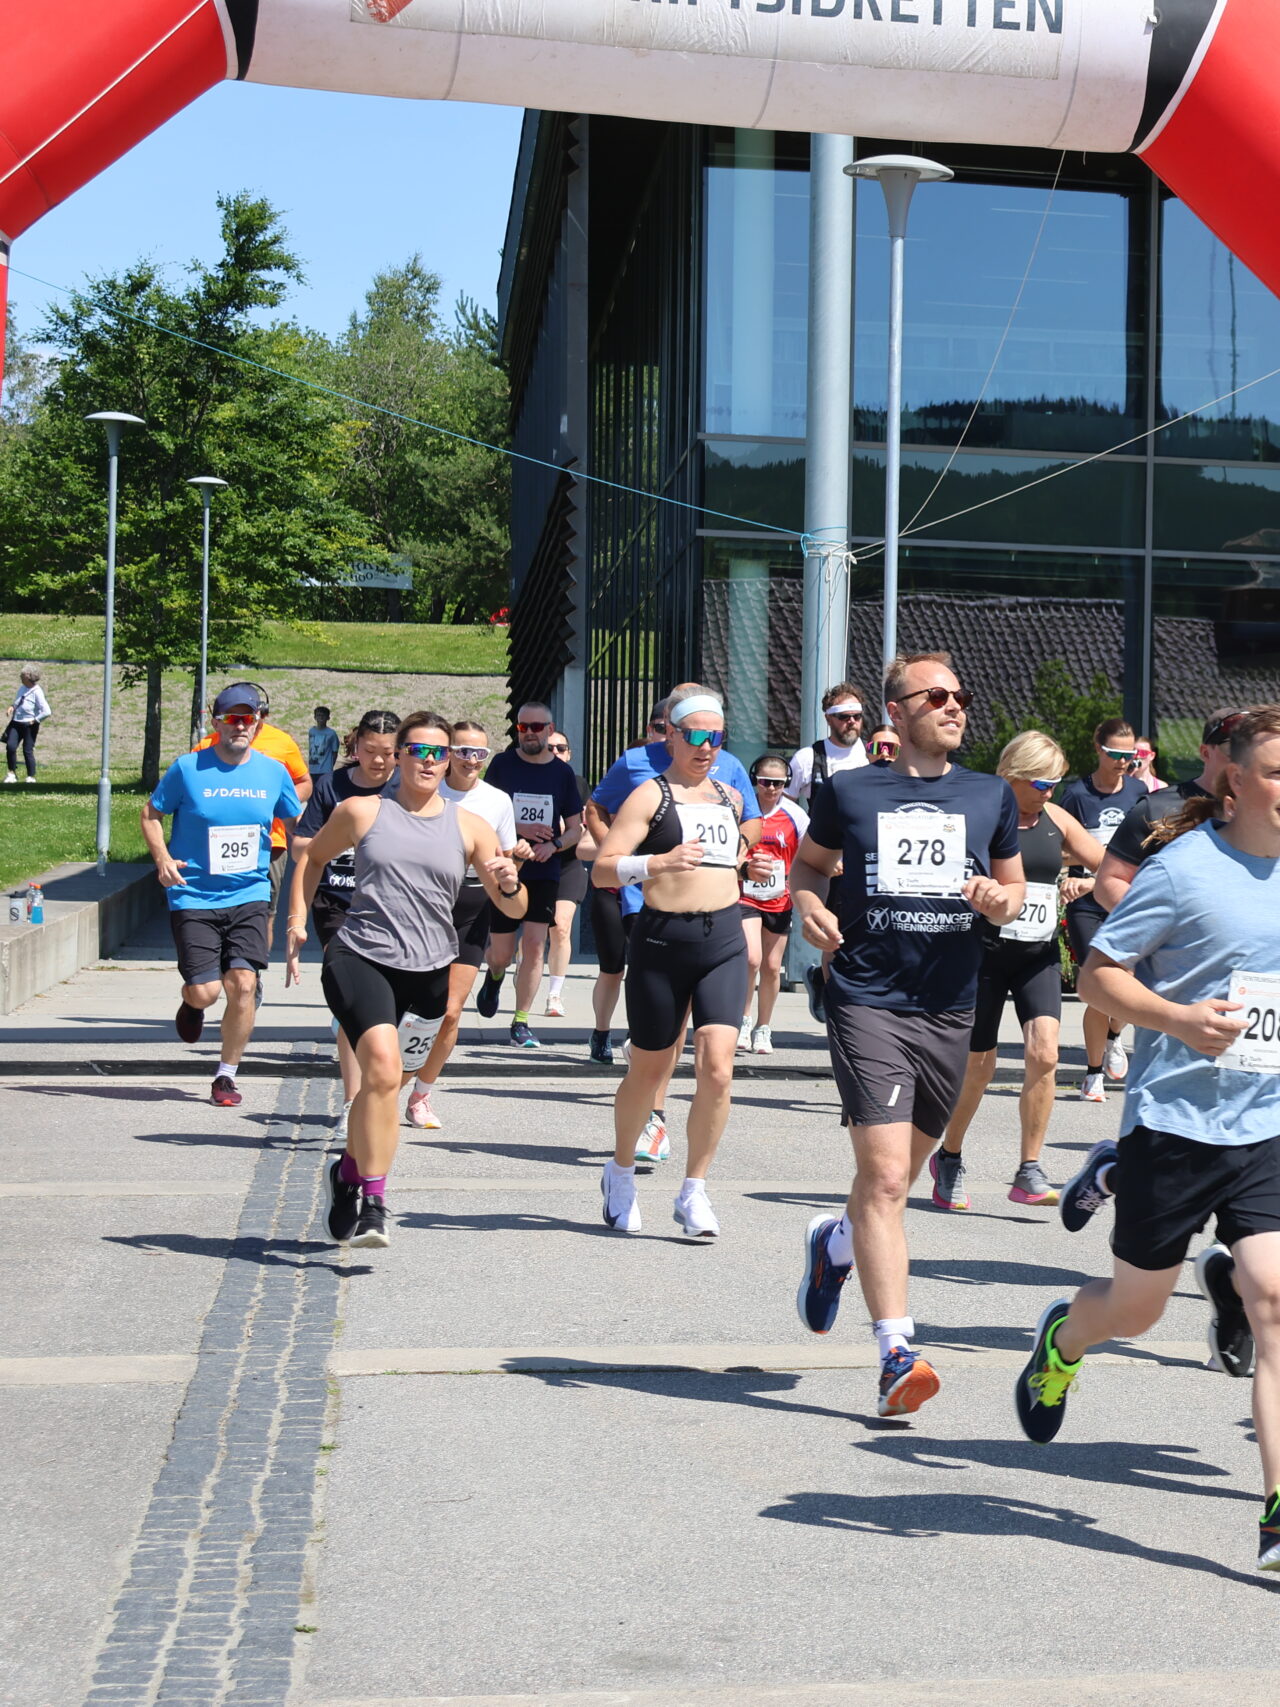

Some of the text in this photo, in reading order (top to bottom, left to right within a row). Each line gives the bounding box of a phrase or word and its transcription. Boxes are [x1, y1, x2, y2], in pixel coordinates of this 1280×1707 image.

[520, 807, 545, 821] 284
[696, 823, 728, 845] 210
[221, 842, 249, 859] 295
[897, 838, 946, 866] 278
[890, 910, 974, 924] KONGSVINGER
[1017, 902, 1047, 924] 270
[892, 922, 971, 933] TRENINGSSENTER
